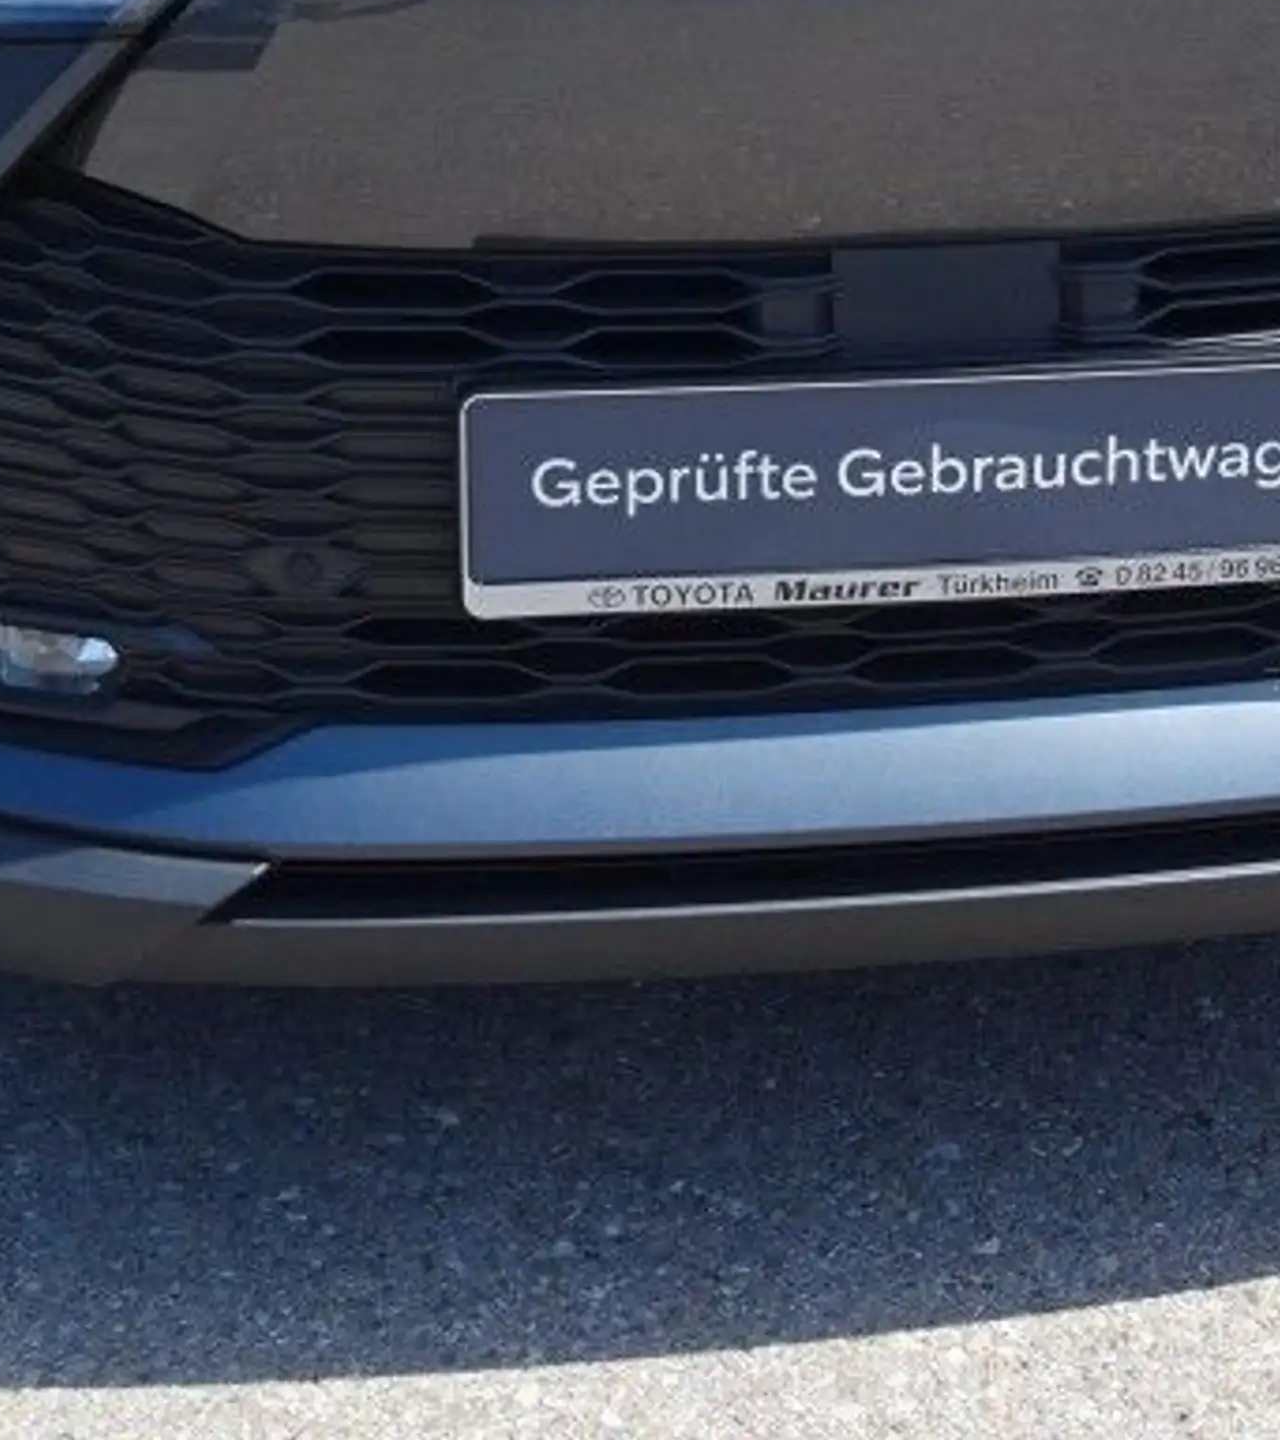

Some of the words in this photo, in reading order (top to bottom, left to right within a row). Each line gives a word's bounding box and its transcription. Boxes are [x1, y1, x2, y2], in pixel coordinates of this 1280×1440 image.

[531, 449, 818, 519] Geprüfte
[631, 582, 755, 608] TOYOTA
[773, 577, 922, 602] Maurer
[935, 569, 1060, 596] Türkheim
